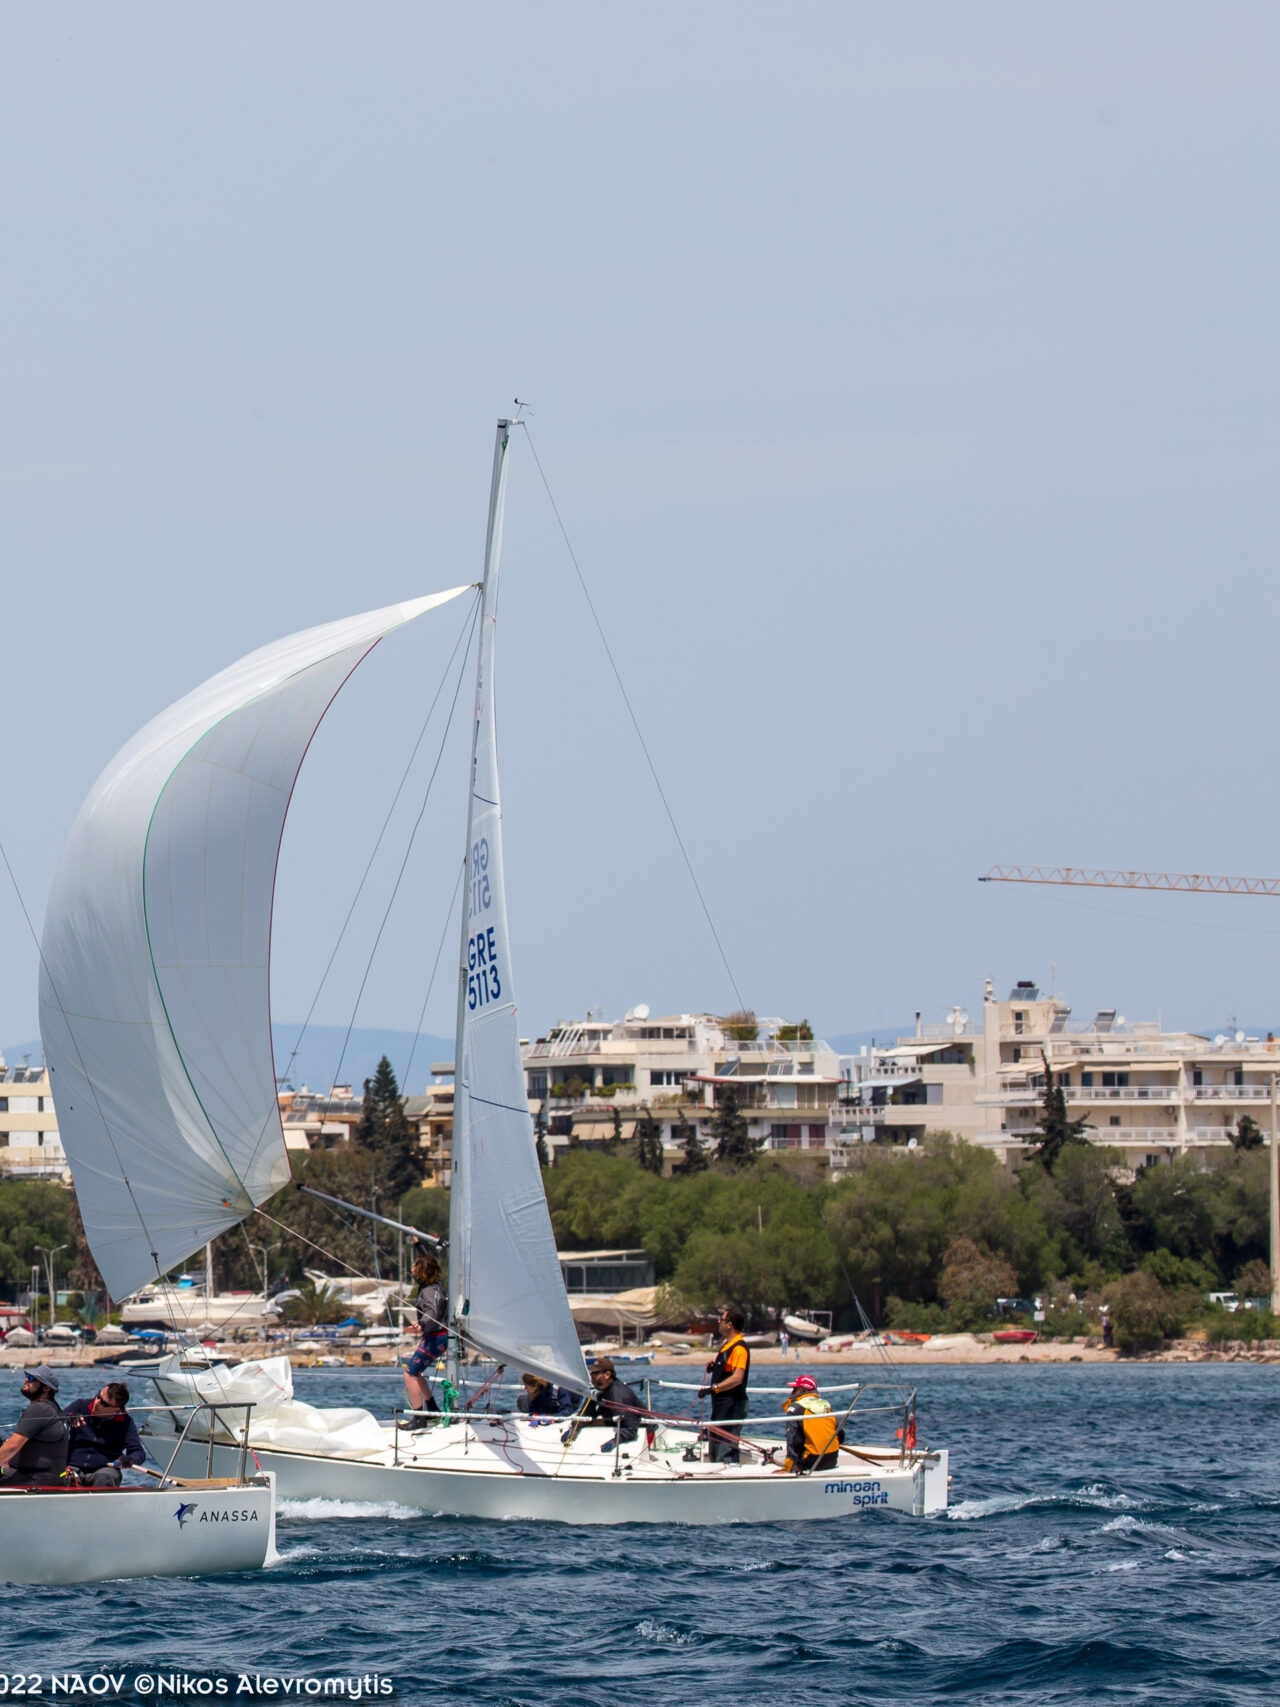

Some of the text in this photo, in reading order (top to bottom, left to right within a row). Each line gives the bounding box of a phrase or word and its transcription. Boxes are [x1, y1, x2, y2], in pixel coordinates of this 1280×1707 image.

[468, 926, 498, 971] GRE
[468, 964, 502, 1011] 5113
[824, 1481, 881, 1494] minoan
[852, 1492, 889, 1507] spirit
[199, 1510, 258, 1523] ANASSA
